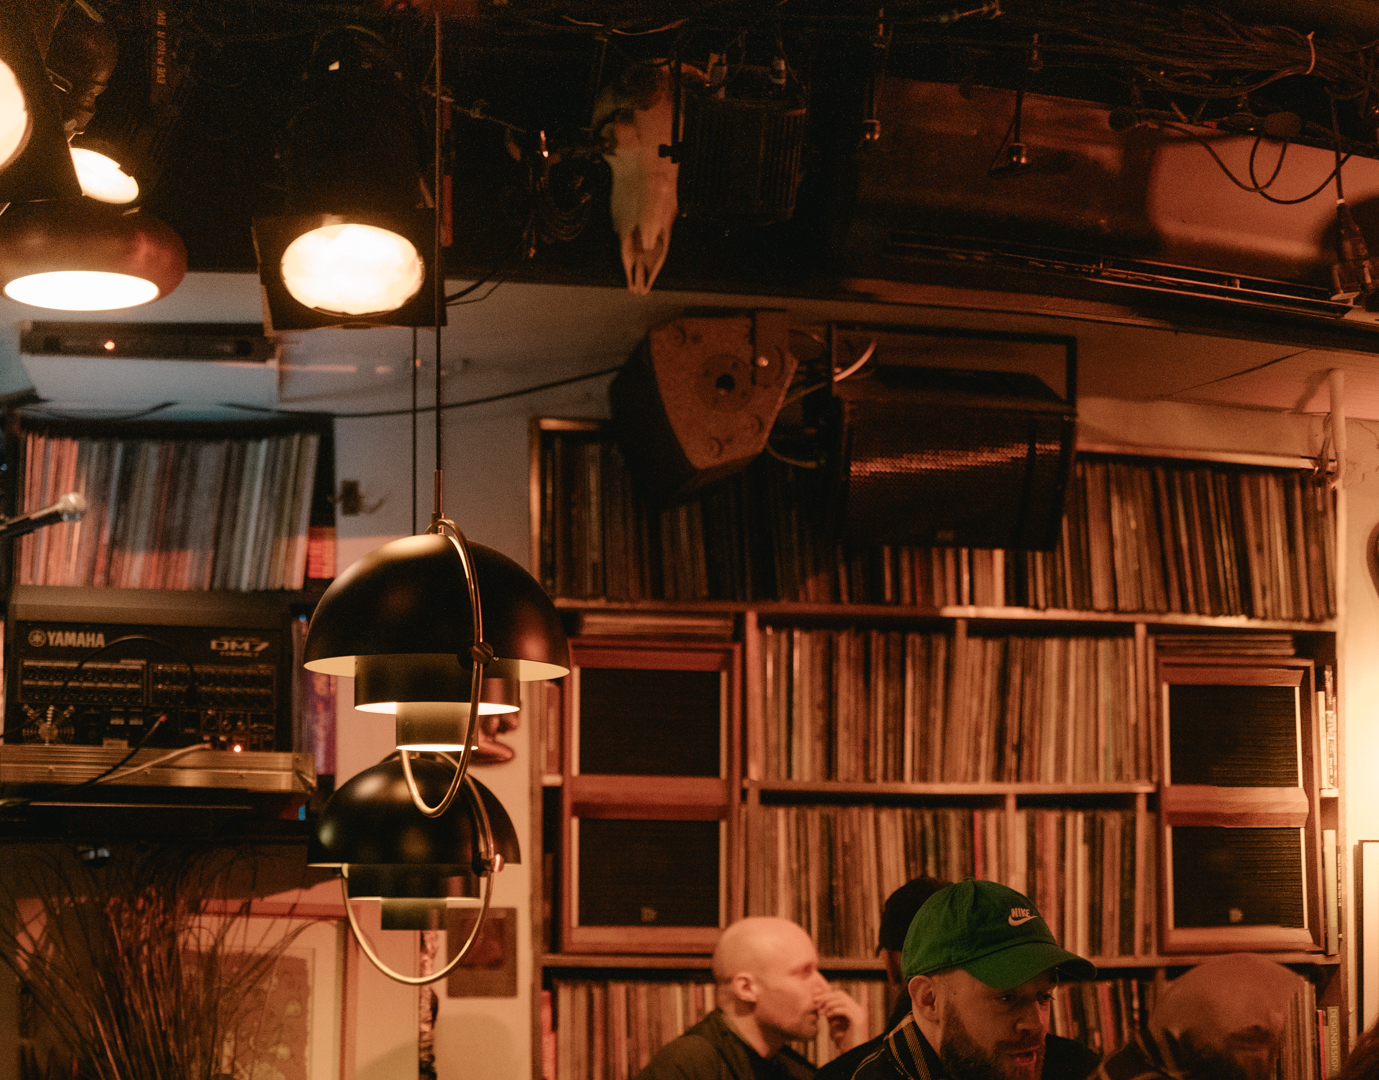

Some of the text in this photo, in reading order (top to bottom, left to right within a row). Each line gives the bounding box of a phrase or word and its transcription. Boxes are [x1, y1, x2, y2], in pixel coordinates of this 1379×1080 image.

[47, 631, 106, 648] YAMAHA
[210, 638, 270, 651] DM7
[1010, 907, 1030, 919] NIKE
